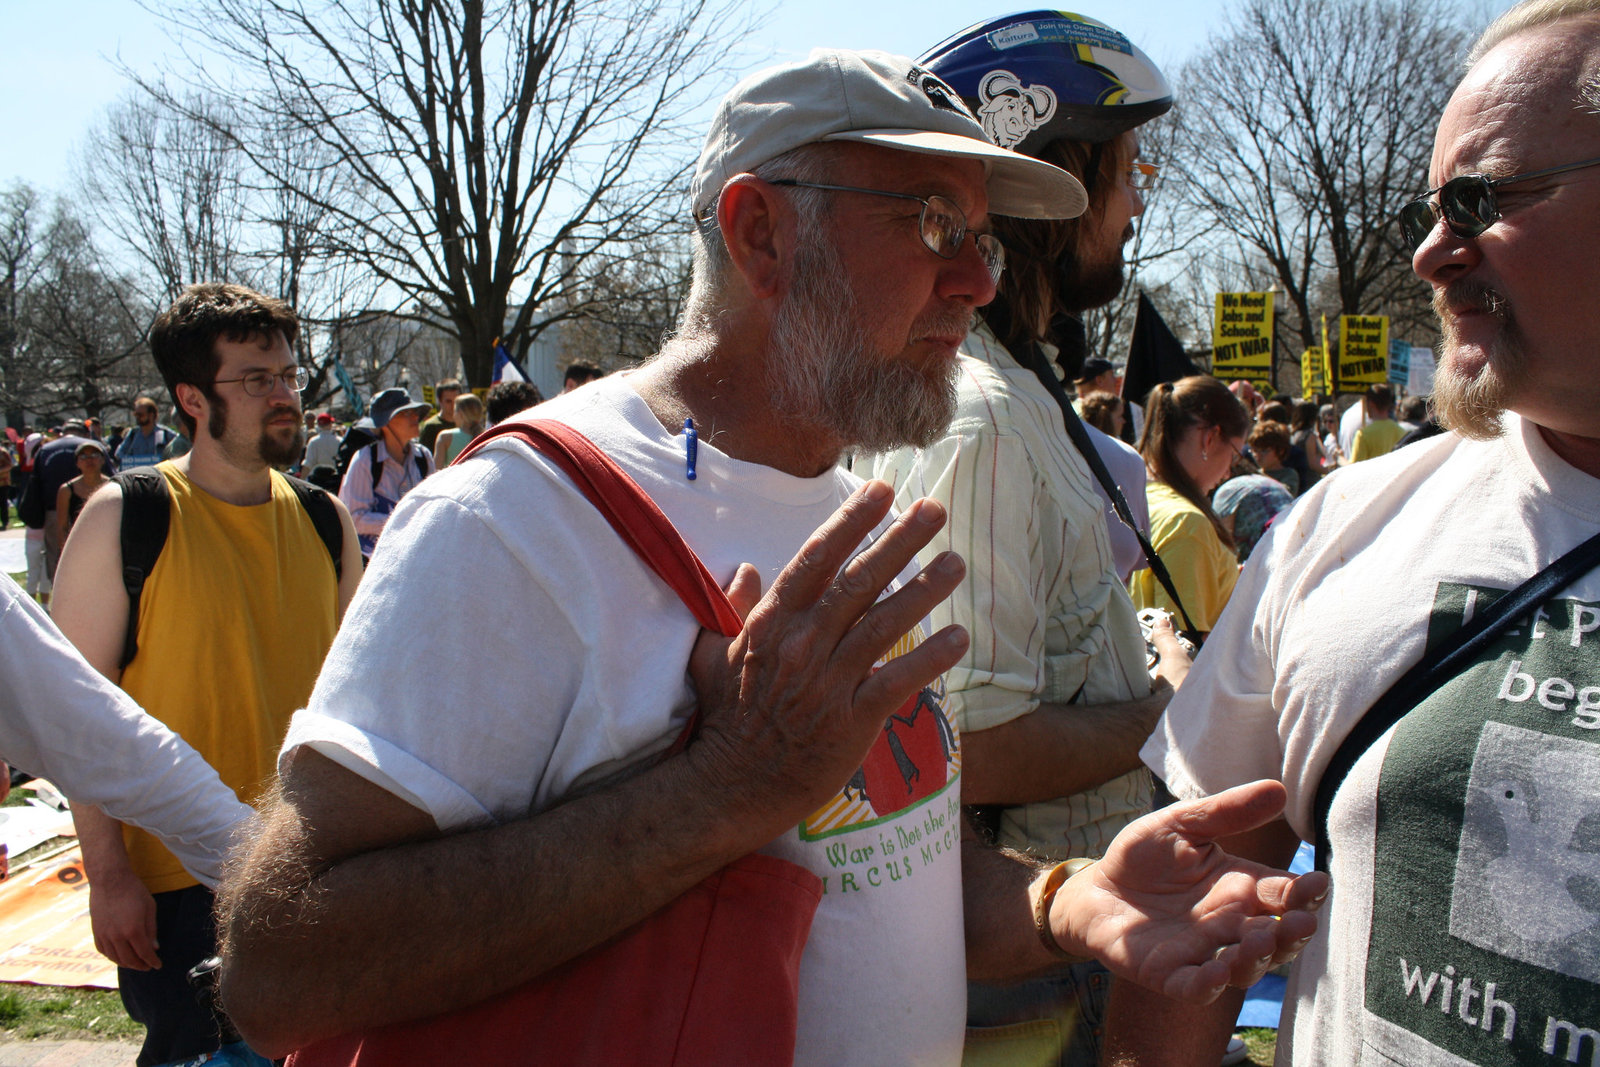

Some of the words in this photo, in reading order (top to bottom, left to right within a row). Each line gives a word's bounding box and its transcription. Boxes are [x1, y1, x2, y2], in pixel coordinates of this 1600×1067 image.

[1073, 24, 1094, 32] Open
[998, 32, 1035, 45] Kaltura
[1222, 294, 1239, 307] We
[1240, 293, 1266, 307] Need
[1221, 309, 1243, 322] Jobs
[1245, 309, 1265, 322] and
[1220, 323, 1260, 337] Schools
[1346, 317, 1360, 329] We
[1361, 317, 1382, 329] Need
[1346, 330, 1364, 343] Jobs
[1365, 331, 1381, 343] and
[1215, 343, 1238, 362] NOT
[1240, 337, 1270, 357] WAR
[1345, 344, 1377, 356] Schools
[1340, 360, 1361, 378] NOT
[1361, 357, 1386, 374] WAR
[1497, 660, 1600, 730] beg
[825, 842, 874, 868] War
[879, 833, 895, 856] is
[895, 825, 922, 850] Not
[924, 809, 945, 835] the
[1399, 957, 1516, 1042] with
